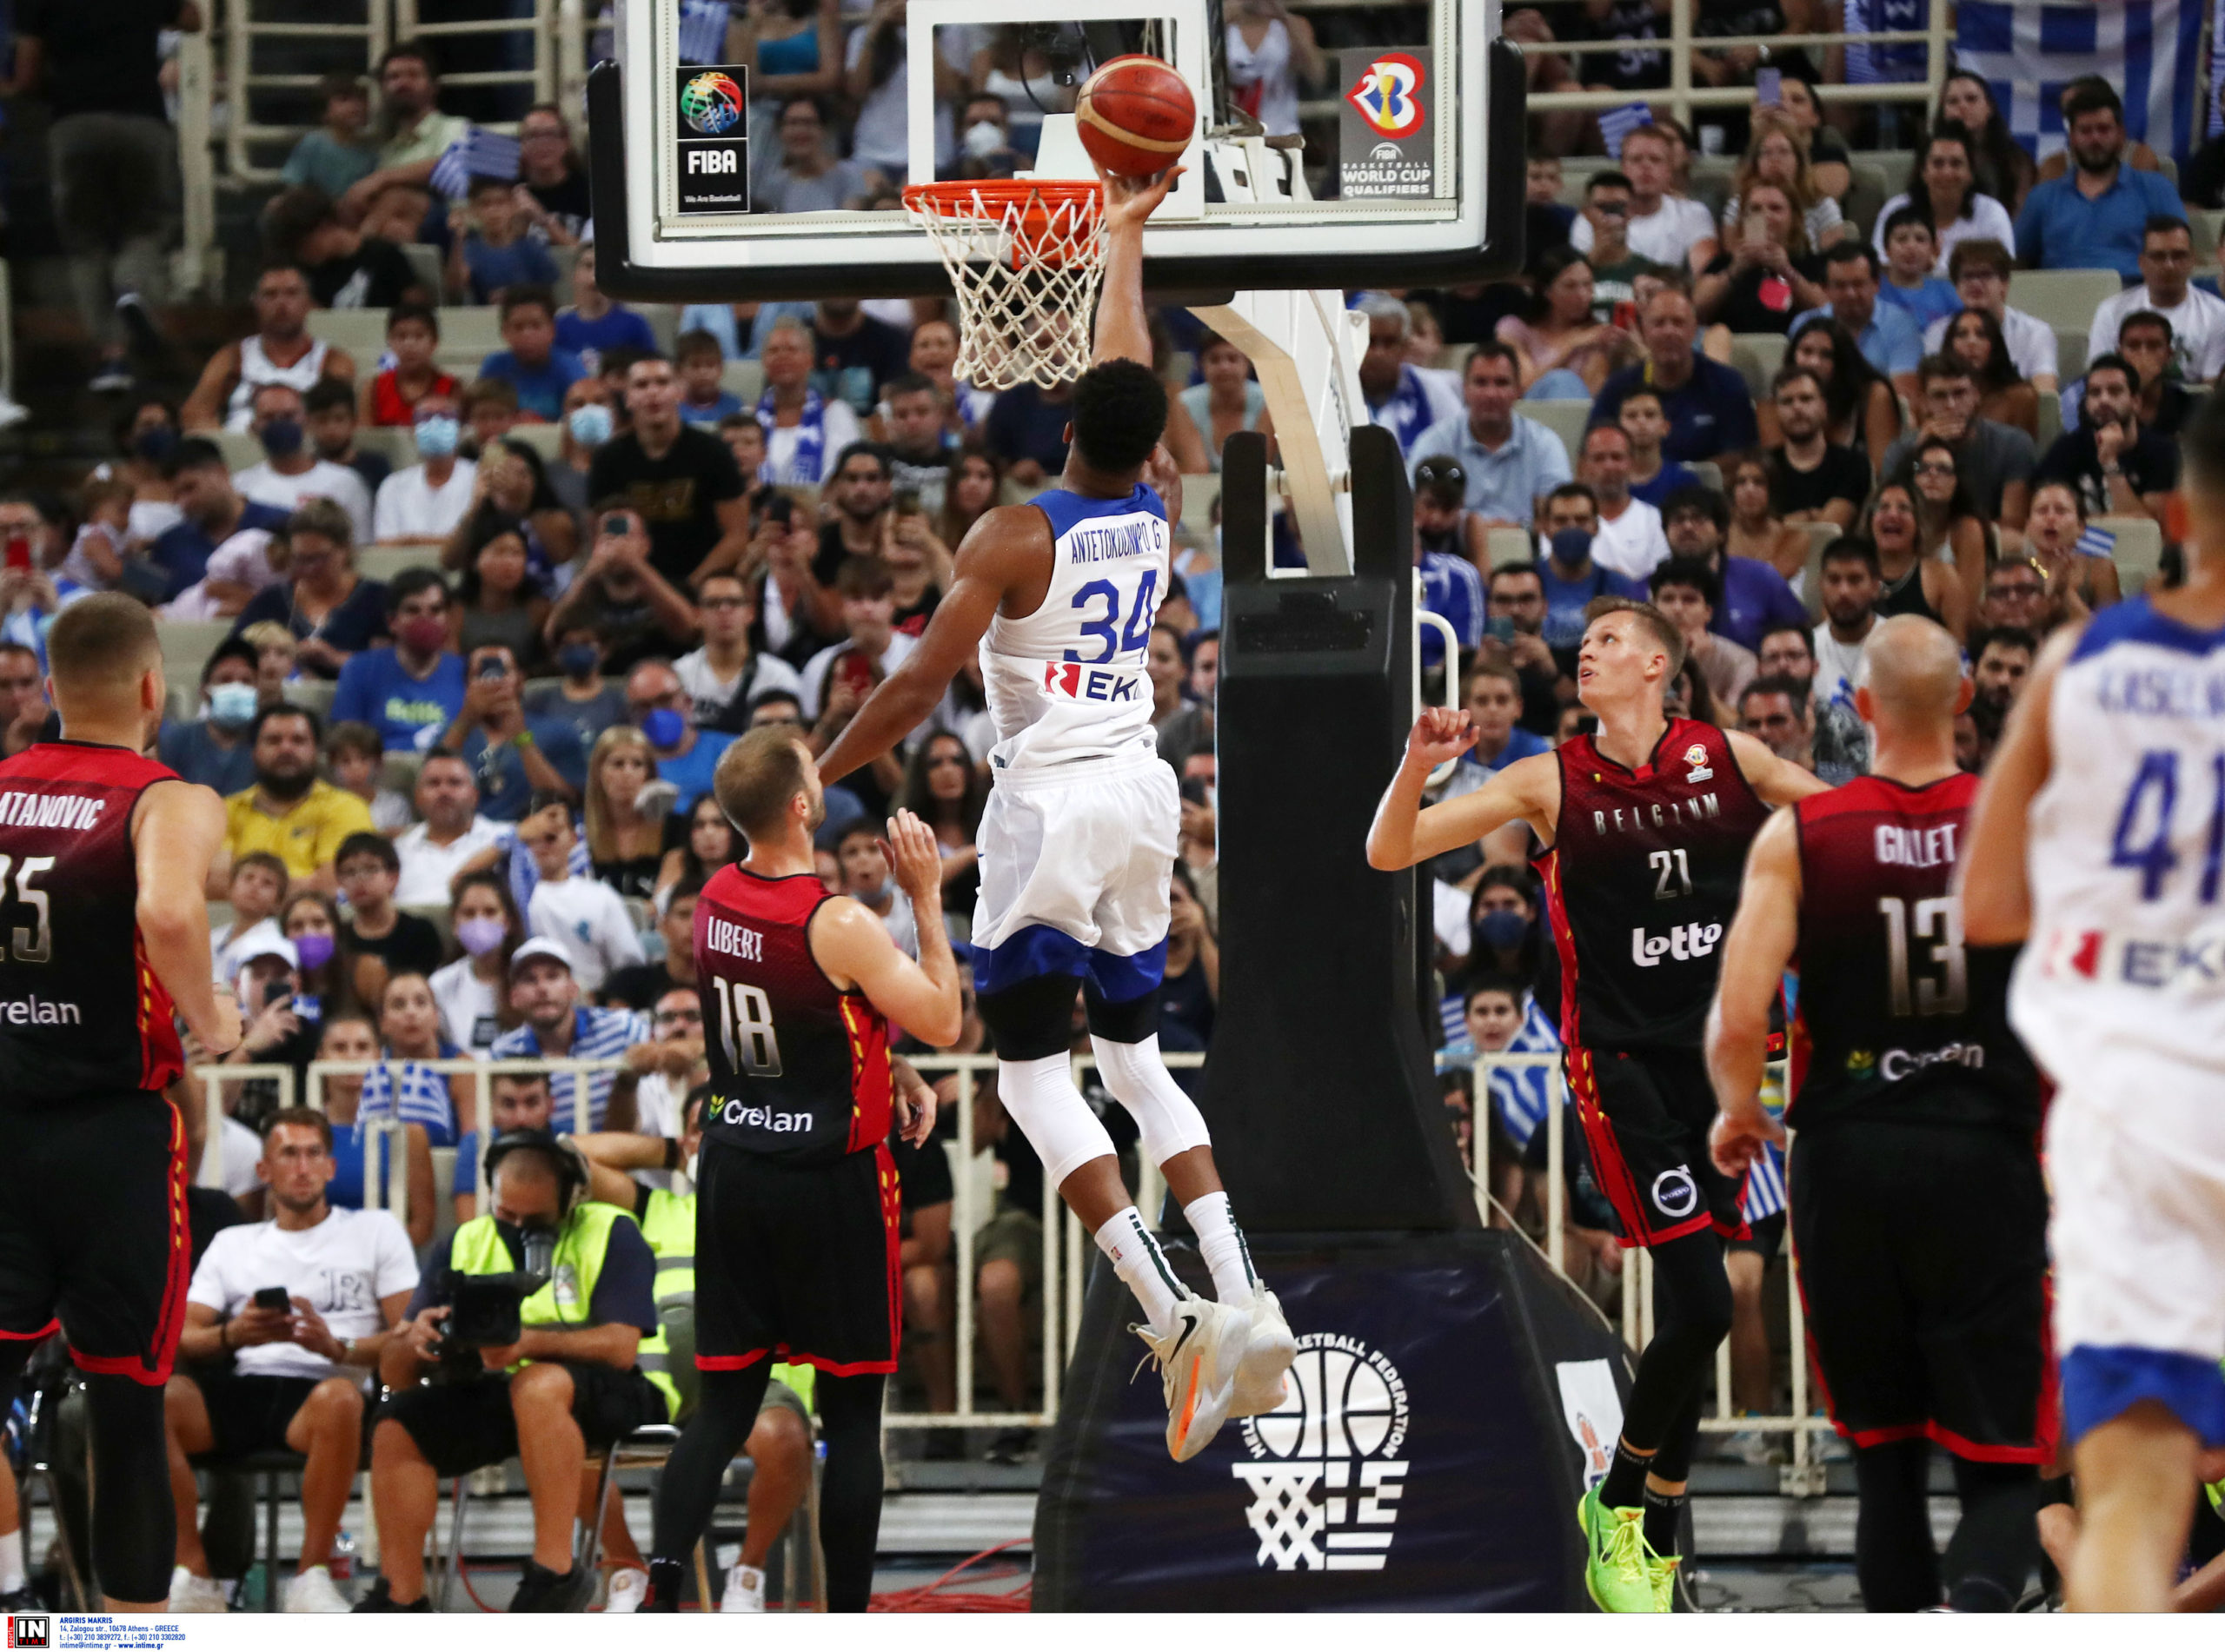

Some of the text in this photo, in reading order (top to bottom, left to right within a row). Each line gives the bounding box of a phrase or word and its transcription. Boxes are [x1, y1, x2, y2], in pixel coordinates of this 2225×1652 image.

[687, 149, 737, 174] FIBA
[1342, 169, 1431, 182] WORLD CUP
[1376, 149, 1397, 160] FIBA
[1343, 184, 1430, 197] QUALIFIERS
[1063, 569, 1157, 665] 34
[1086, 671, 1138, 702] EK
[2110, 749, 2225, 906] 41
[1649, 848, 1693, 899] 21
[707, 916, 763, 962] LIBERT
[1631, 921, 1723, 967] Lotto
[1878, 896, 1967, 1016] 13
[2121, 939, 2225, 989] EK
[713, 975, 782, 1078] 18
[724, 1098, 813, 1132] Crelan
[1294, 1332, 1366, 1357] KETBALL
[1367, 1349, 1410, 1460] FEDERATION
